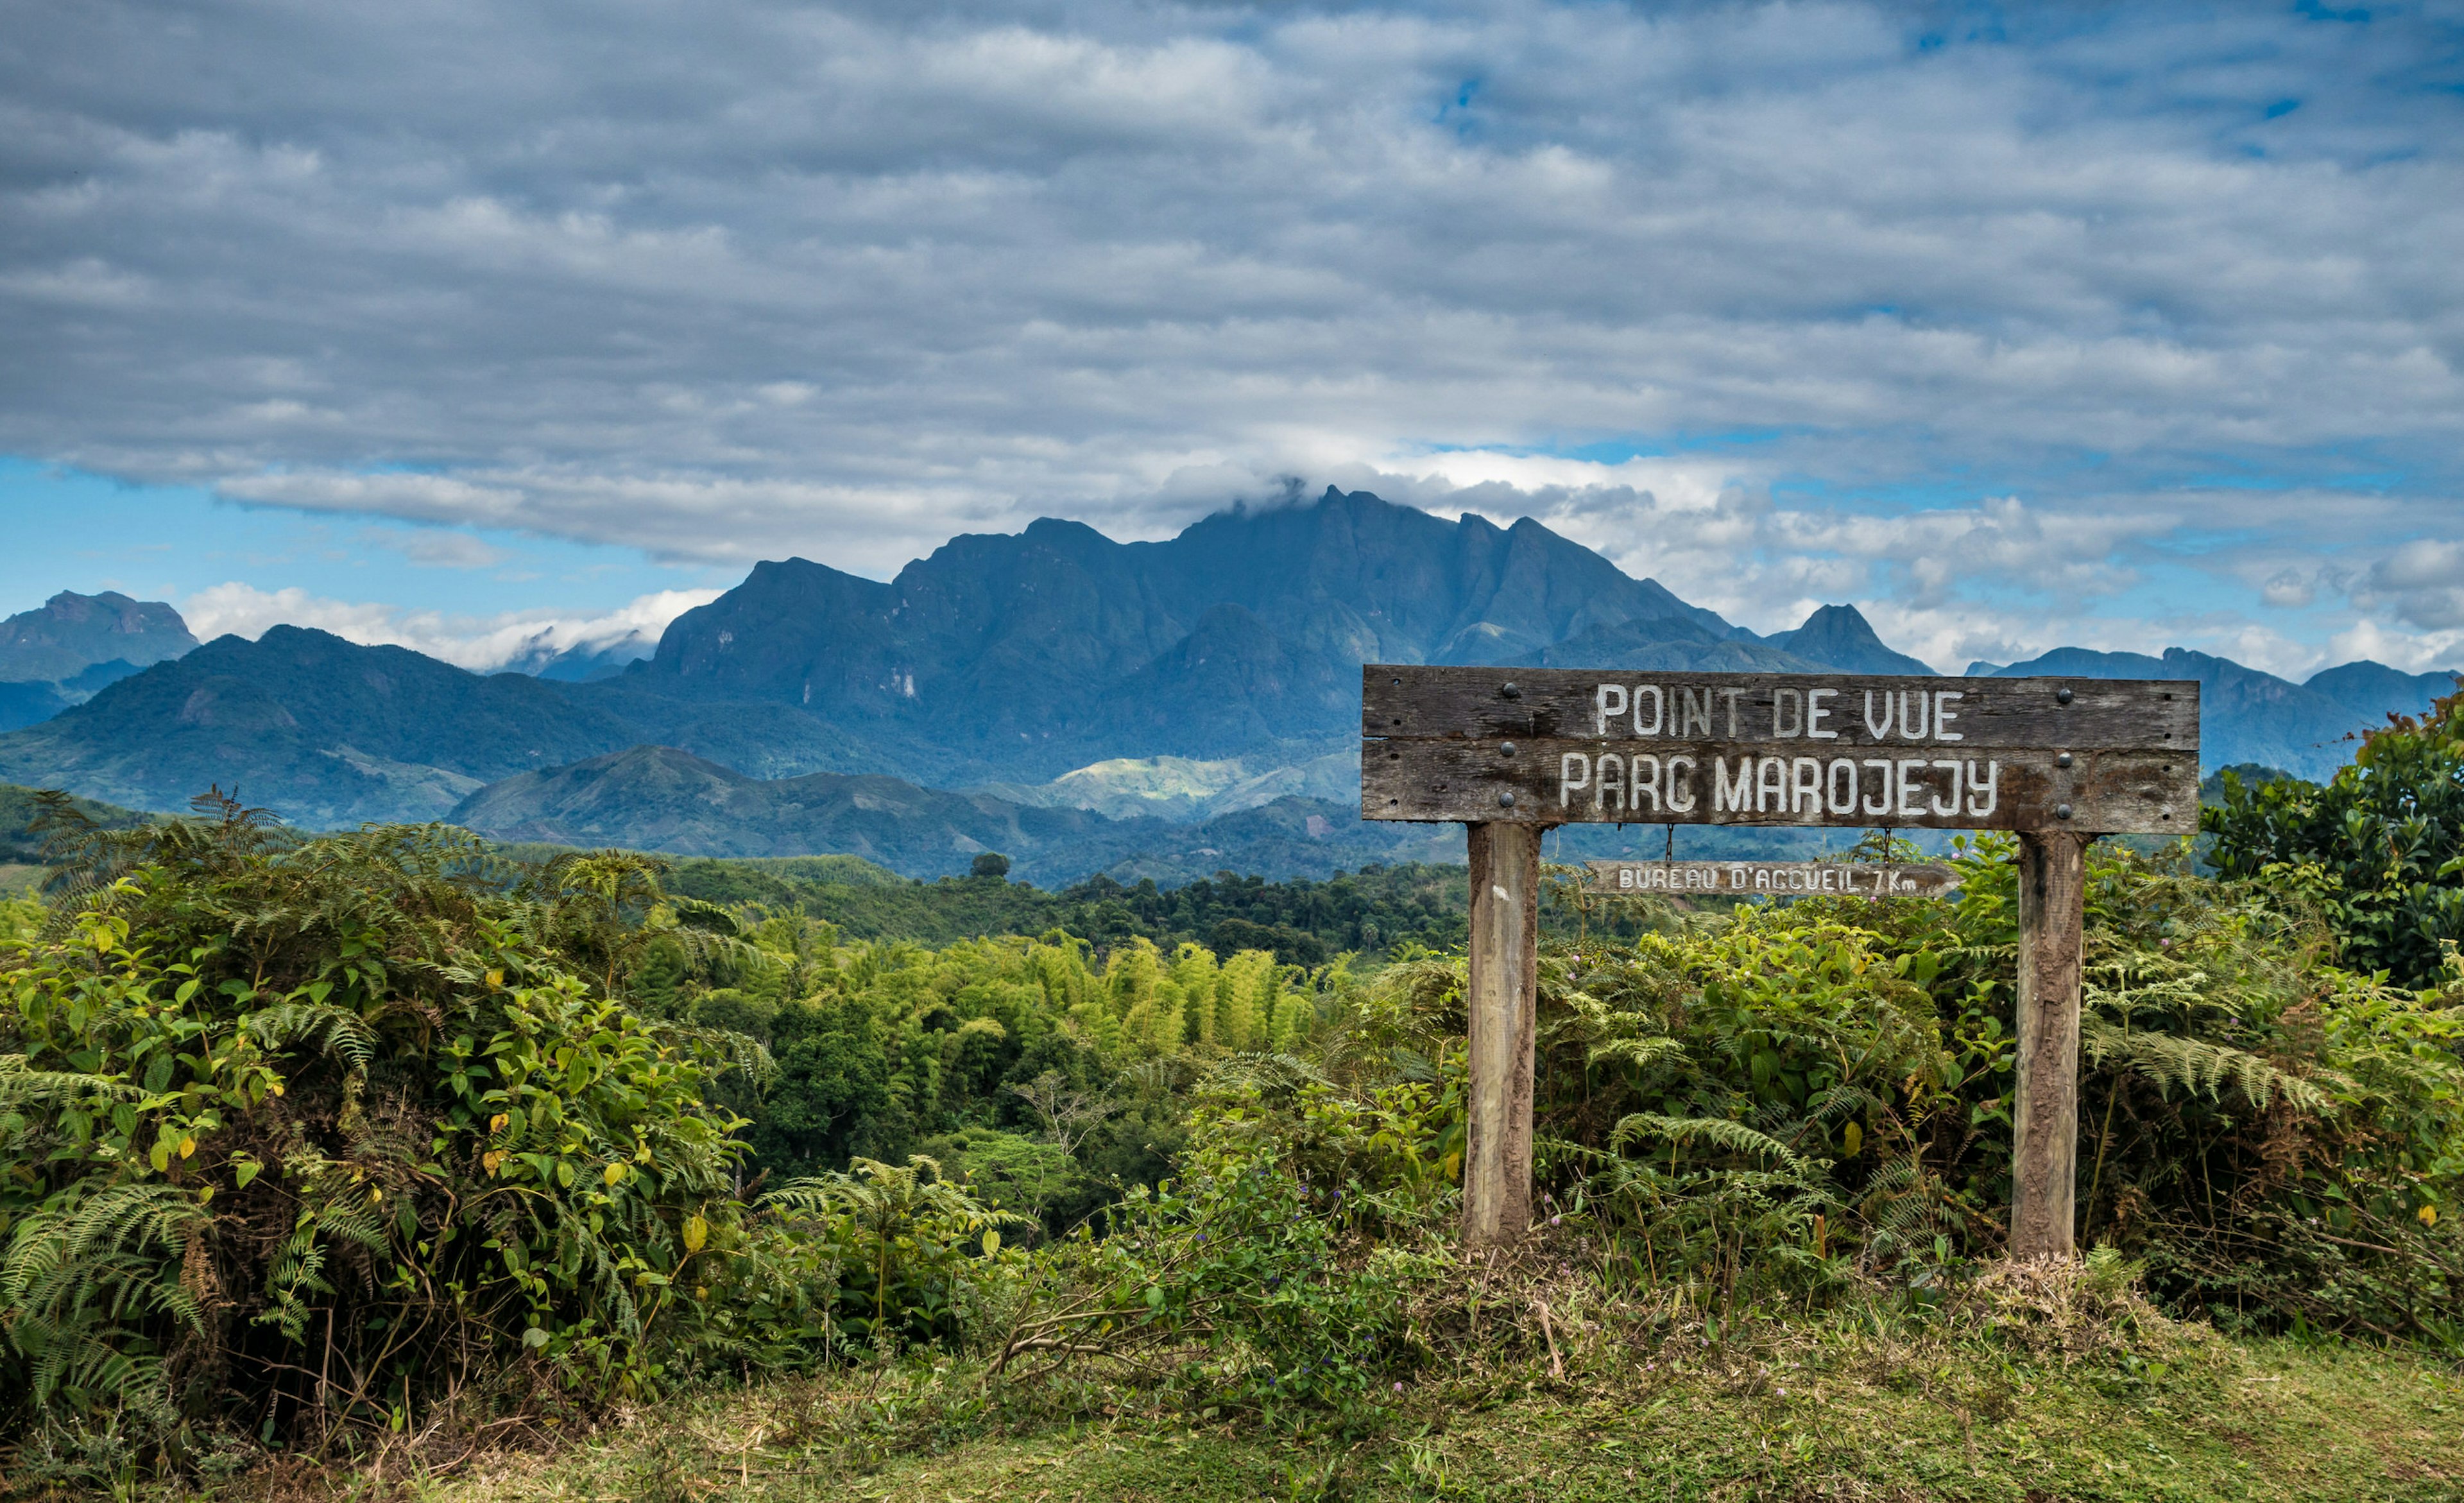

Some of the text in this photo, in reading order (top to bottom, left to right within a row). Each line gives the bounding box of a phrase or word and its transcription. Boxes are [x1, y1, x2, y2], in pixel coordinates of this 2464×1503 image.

[1596, 683, 1964, 741] POINT DE VUE
[1560, 752, 1998, 817] PARC MAROJEJY
[1619, 868, 1718, 889] BUREAU
